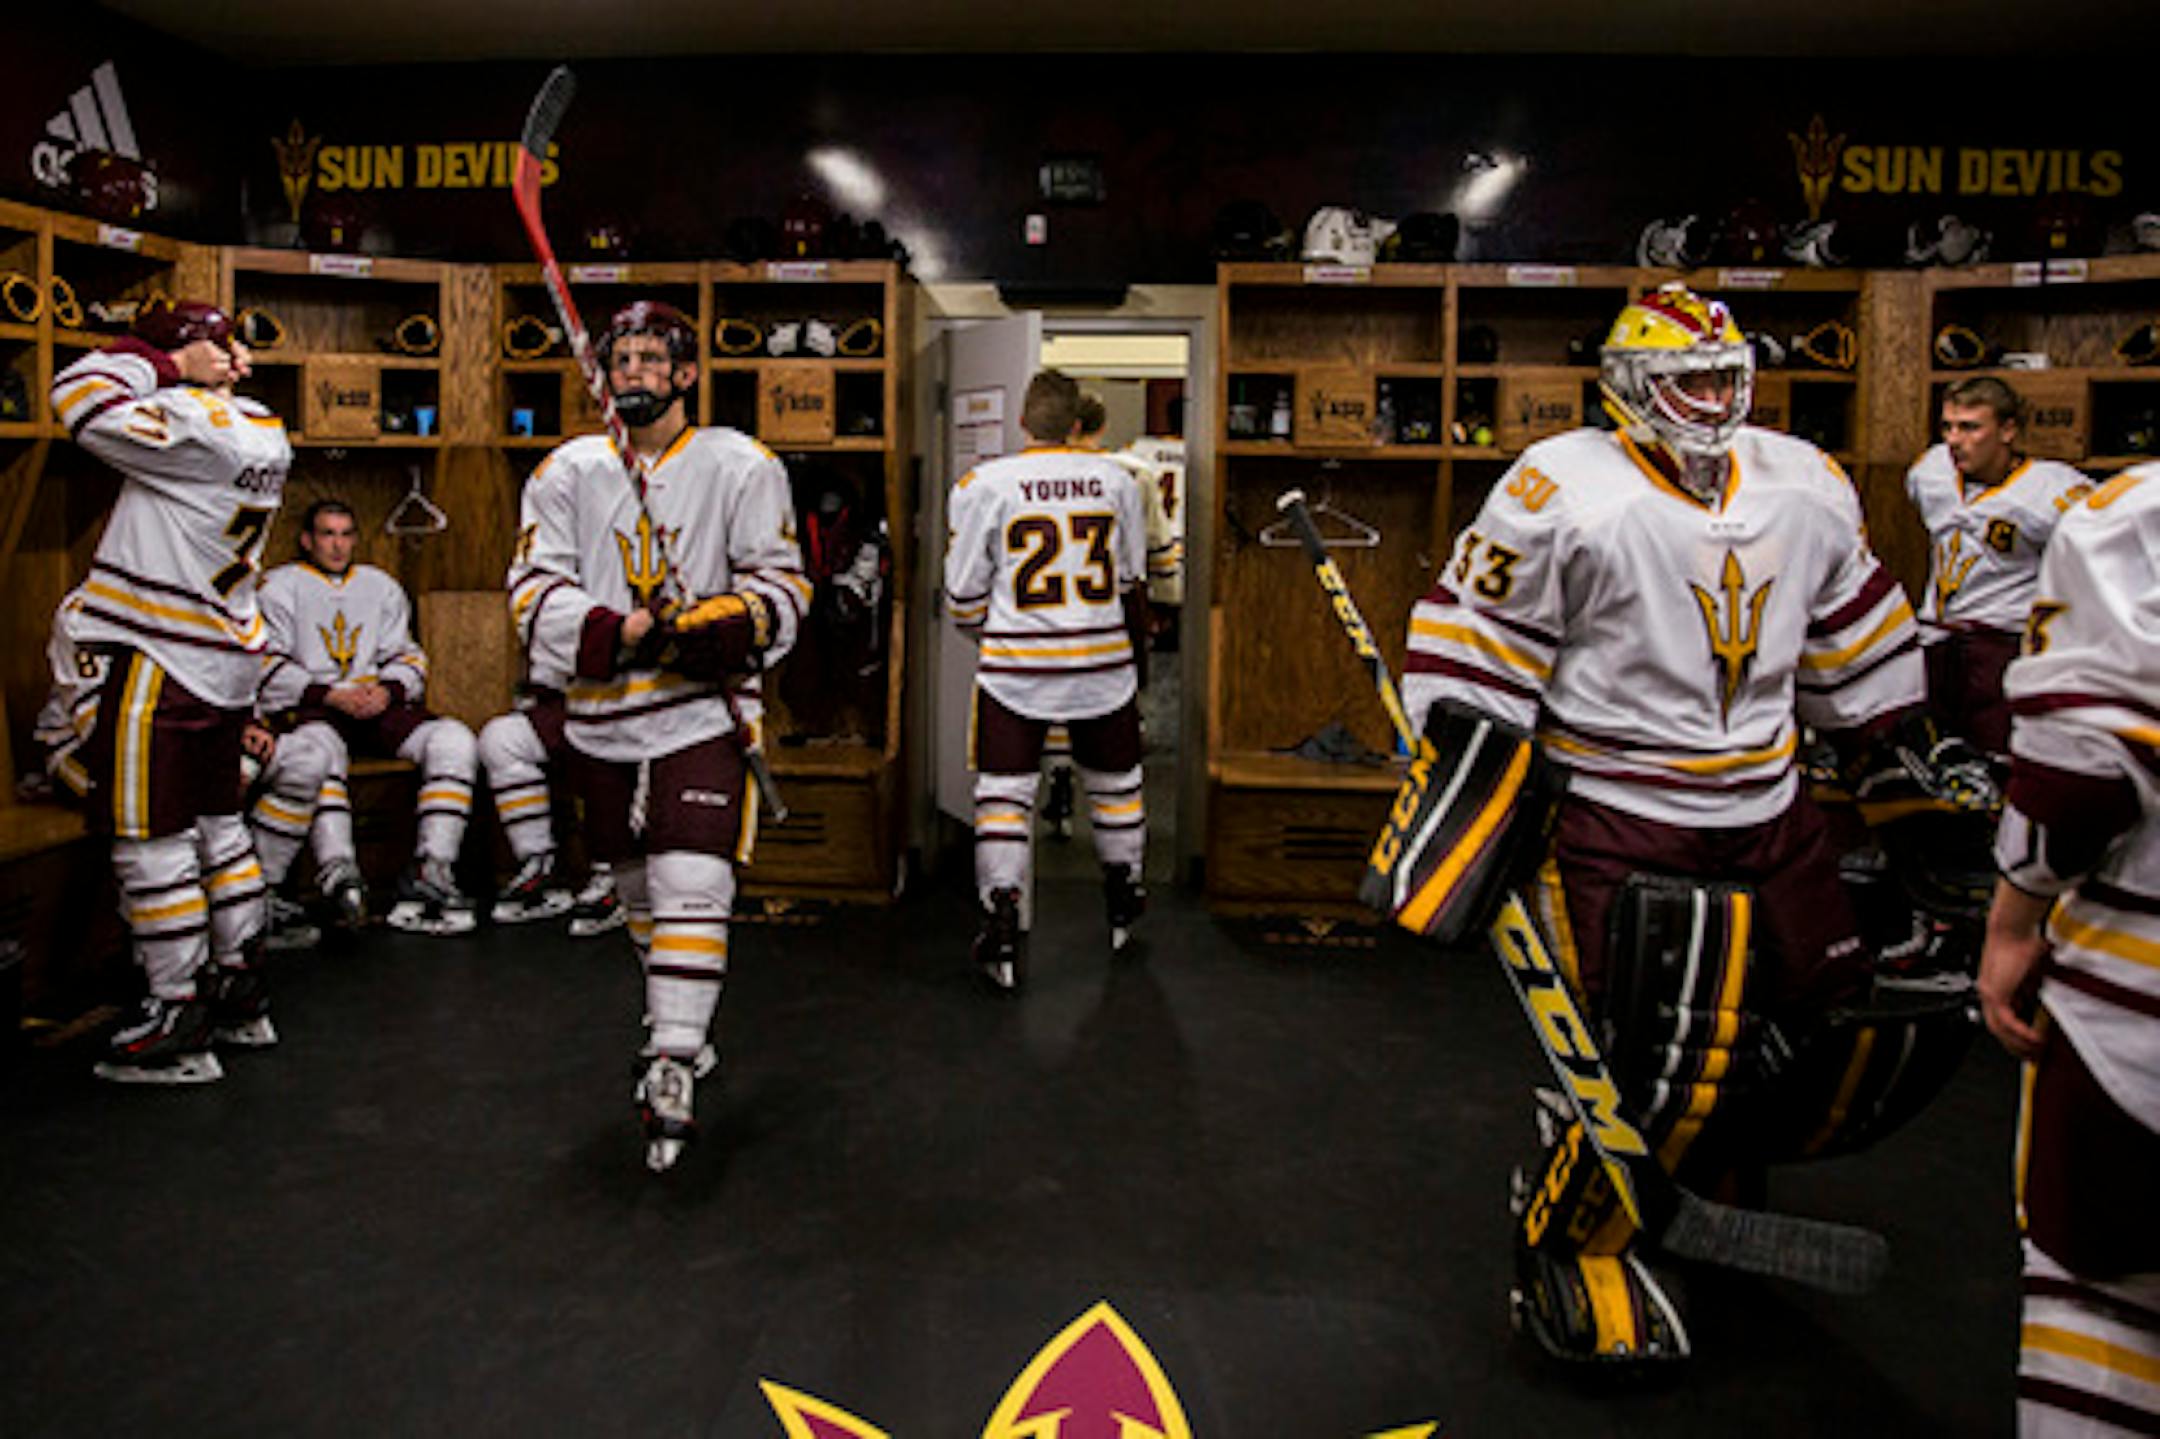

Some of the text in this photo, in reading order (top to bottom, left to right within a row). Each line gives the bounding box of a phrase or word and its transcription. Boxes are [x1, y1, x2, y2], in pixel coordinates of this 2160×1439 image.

[316, 145, 404, 193] SUN
[1842, 146, 2124, 198] SUN DEVILS
[1019, 478, 1105, 502] YOUNG
[1006, 511, 1116, 612] 23
[1369, 733, 1440, 876] CCM
[1492, 890, 1650, 1156] CCM
